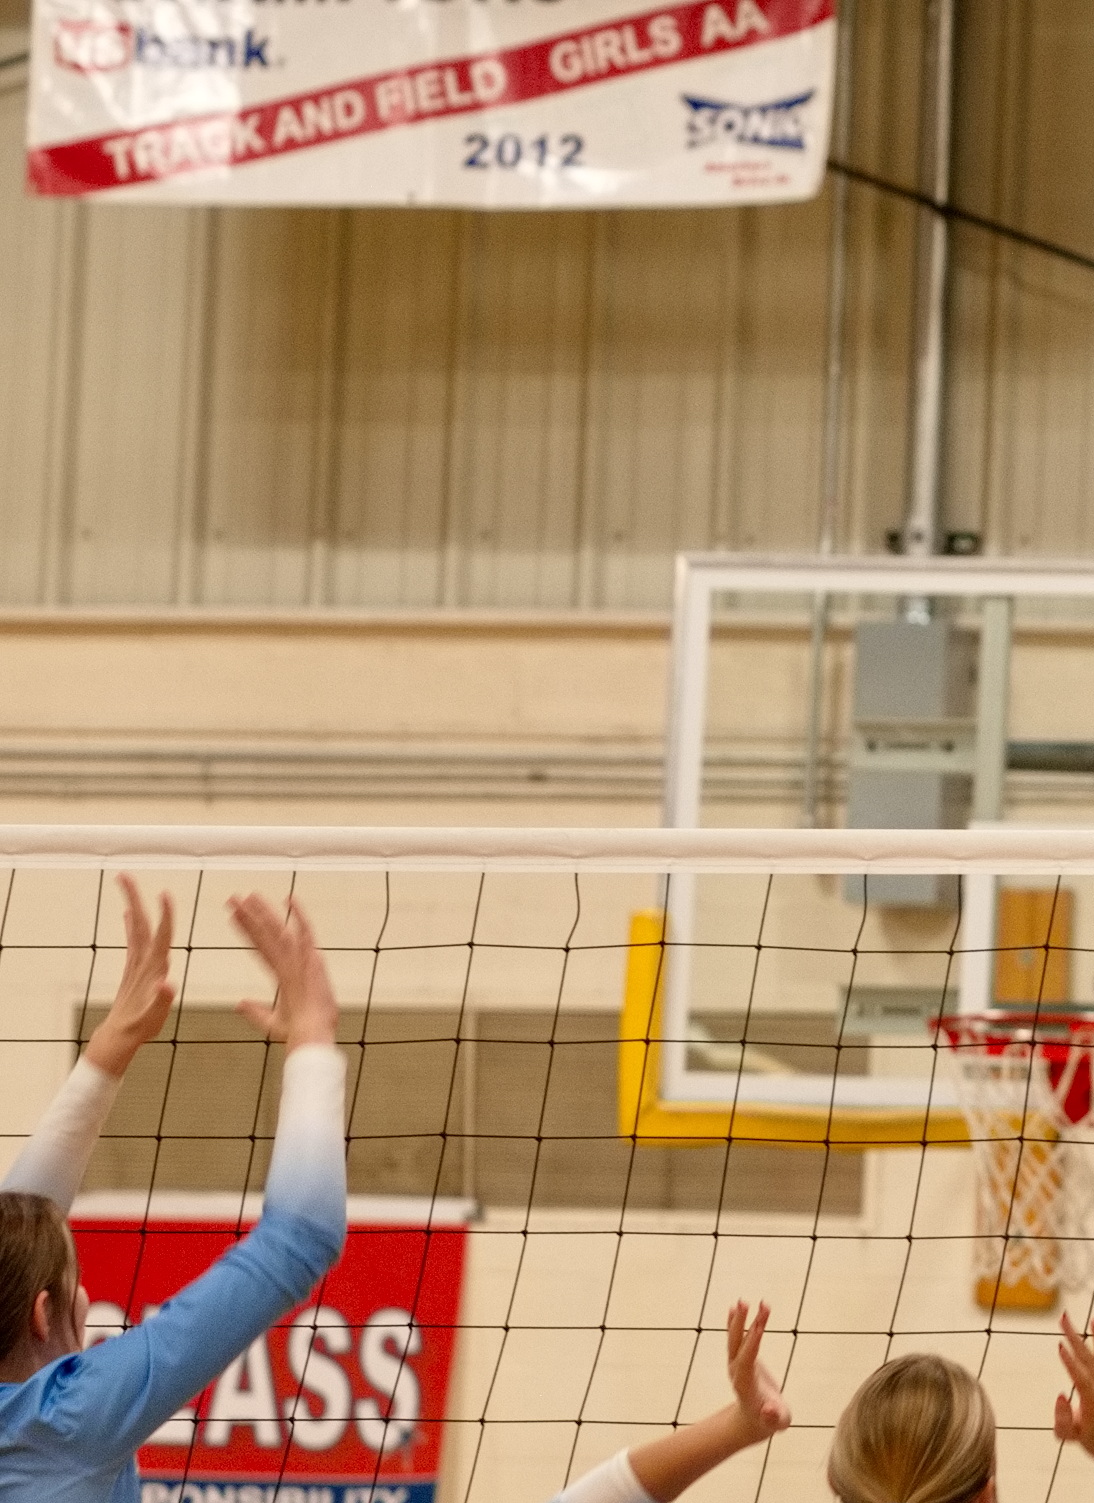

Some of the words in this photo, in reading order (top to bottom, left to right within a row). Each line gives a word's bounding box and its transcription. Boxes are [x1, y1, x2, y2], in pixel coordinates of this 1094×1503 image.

[103, 113, 266, 180] TRACK
[273, 90, 367, 148] AND
[375, 57, 508, 123] FIELD
[549, 15, 683, 83] GIRLS
[702, 1, 771, 47] AA
[463, 133, 584, 169] 2012
